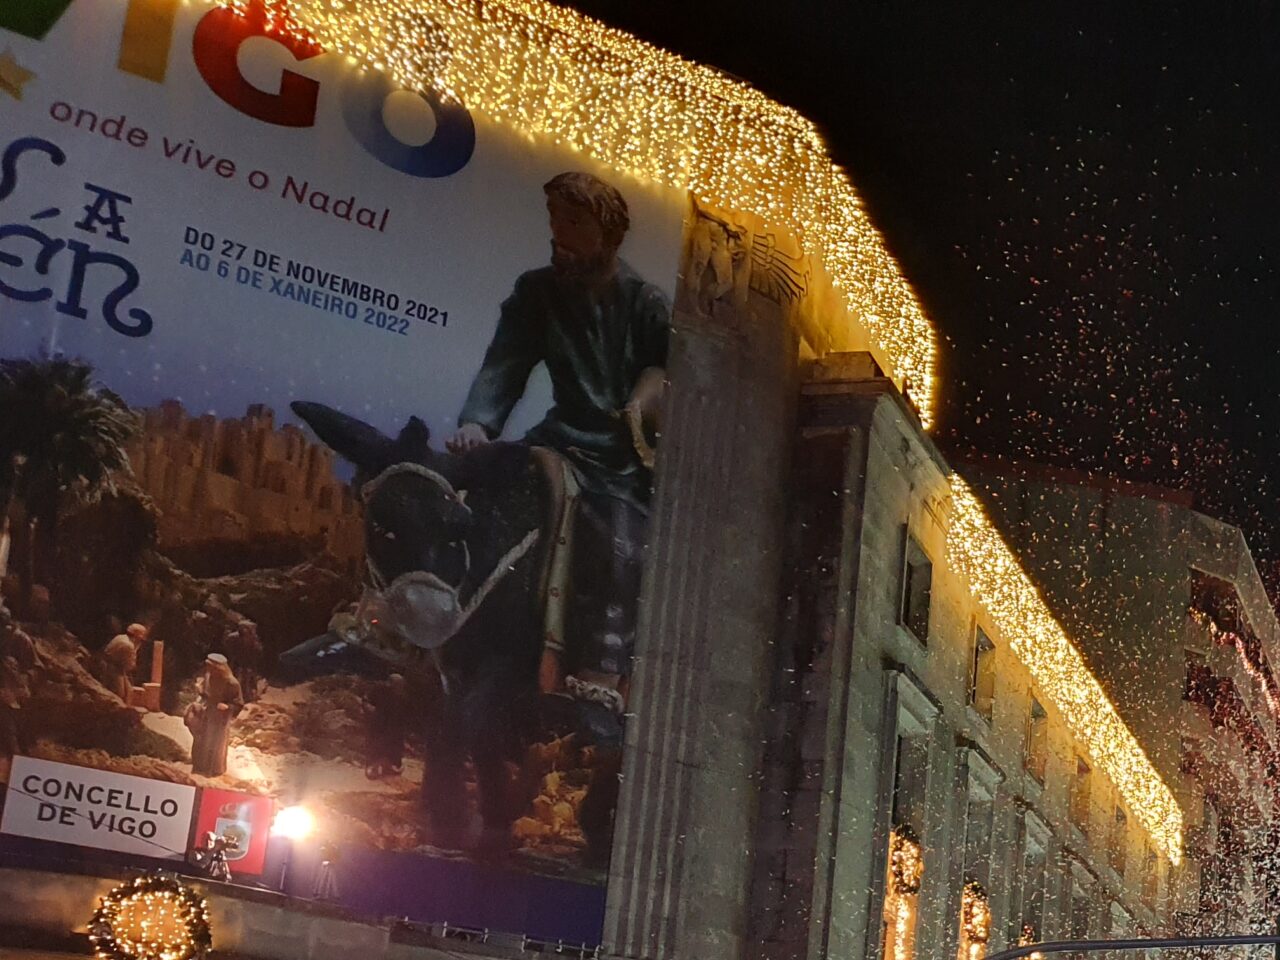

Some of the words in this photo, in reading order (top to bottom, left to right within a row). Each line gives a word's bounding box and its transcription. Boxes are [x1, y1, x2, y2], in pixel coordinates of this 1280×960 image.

[0, 0, 477, 178] IGO
[50, 101, 148, 148] onde
[163, 138, 236, 180] vive
[248, 168, 270, 192] o
[281, 176, 390, 233] Nadal
[74, 182, 133, 245] A
[180, 249, 210, 271] AO
[217, 261, 229, 278] 6
[236, 266, 263, 289] DE
[269, 276, 358, 320] XANEIRO
[364, 307, 410, 335] 2022
[184, 226, 214, 251] DO
[221, 239, 247, 260] 27
[253, 249, 281, 272] DE
[286, 260, 400, 311] NOVEMBRO
[405, 299, 449, 327] 2021
[22, 774, 179, 818] CONCELLO
[37, 803, 76, 827] DE
[88, 810, 158, 839] VIGO
